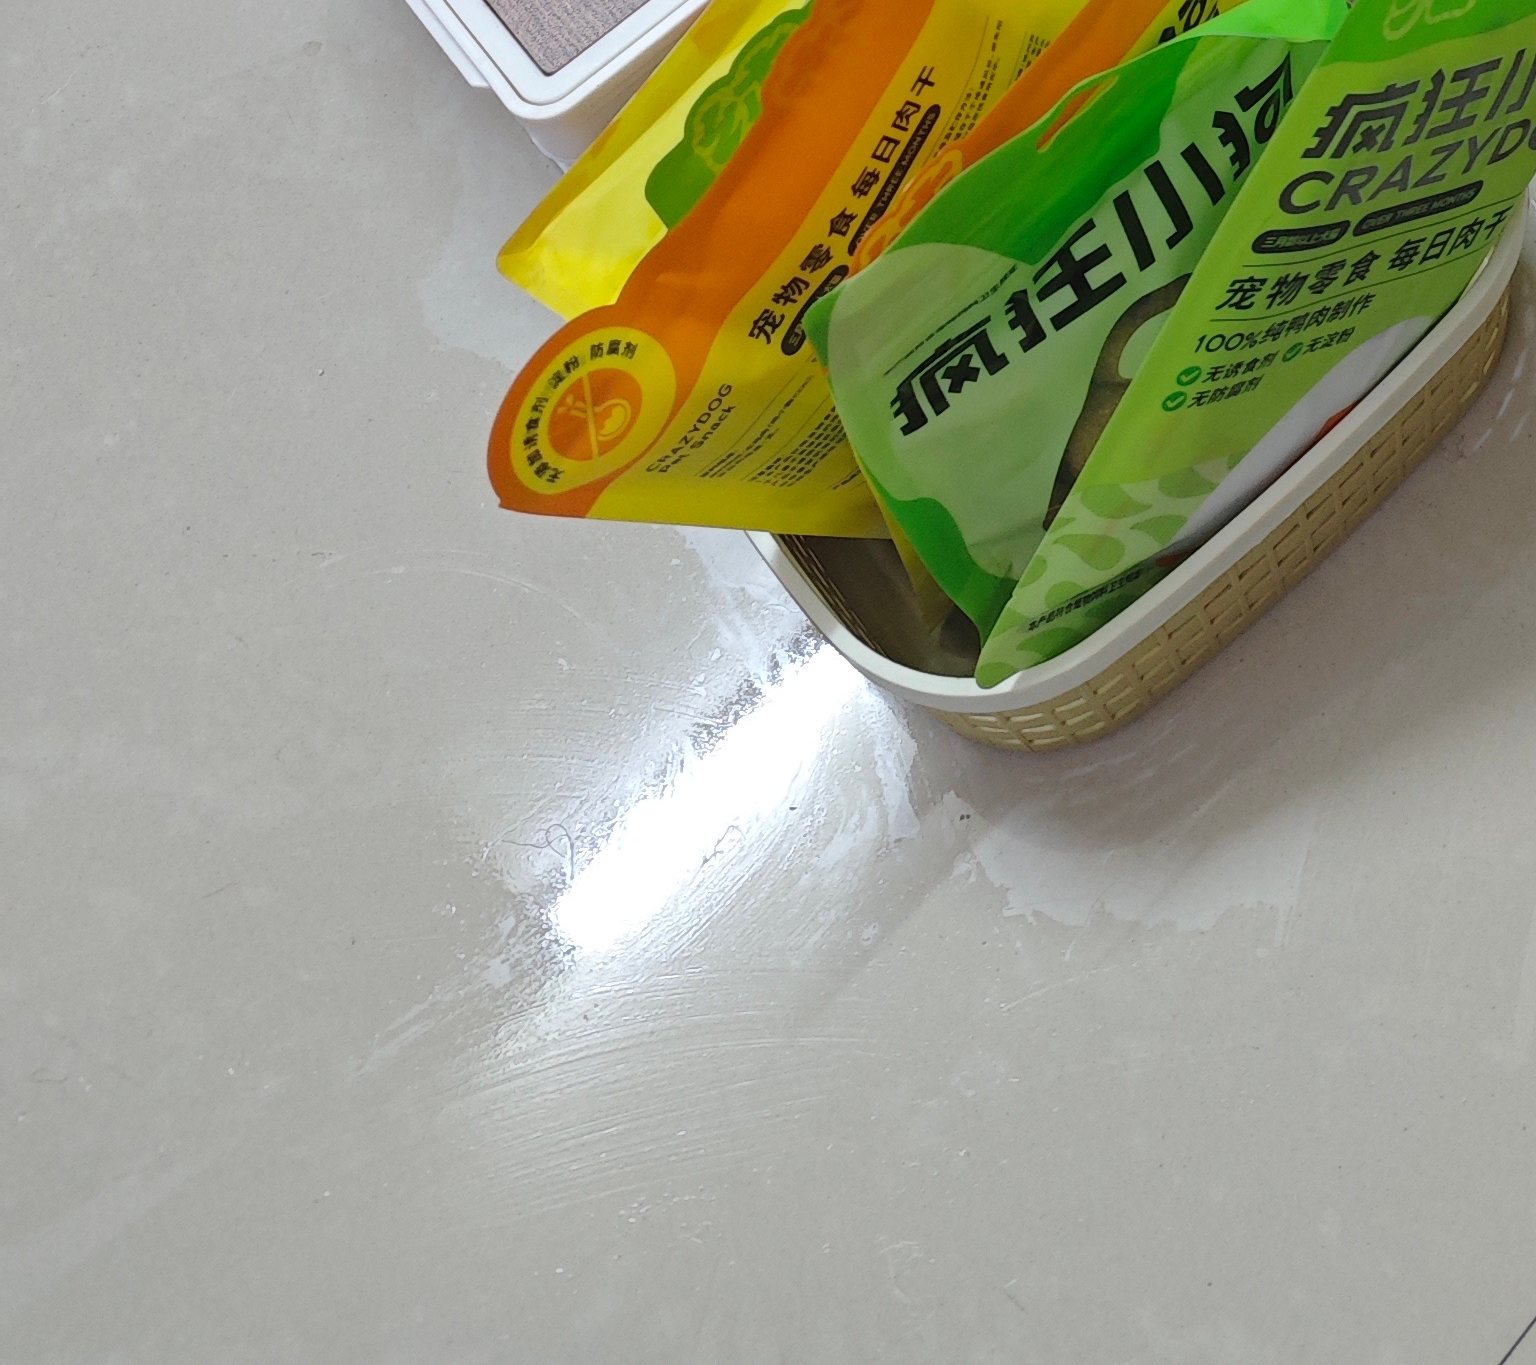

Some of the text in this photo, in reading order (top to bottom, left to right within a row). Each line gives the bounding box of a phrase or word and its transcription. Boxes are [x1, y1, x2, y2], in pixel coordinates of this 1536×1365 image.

[747, 206, 859, 346] 宠物零食
[849, 64, 937, 200] 每日肉干
[878, 169, 903, 209] THREE
[900, 112, 936, 169] MONTHS
[890, 50, 1293, 436] 疯狂小狗
[1214, 203, 1514, 312] 宠物零食 每日肉干
[589, 338, 639, 360] 防腐剂
[1193, 293, 1377, 354] 100%纯鸭肉制作
[645, 382, 733, 473] CRAZYDOG
[1187, 376, 1263, 408] 无防腐剂
